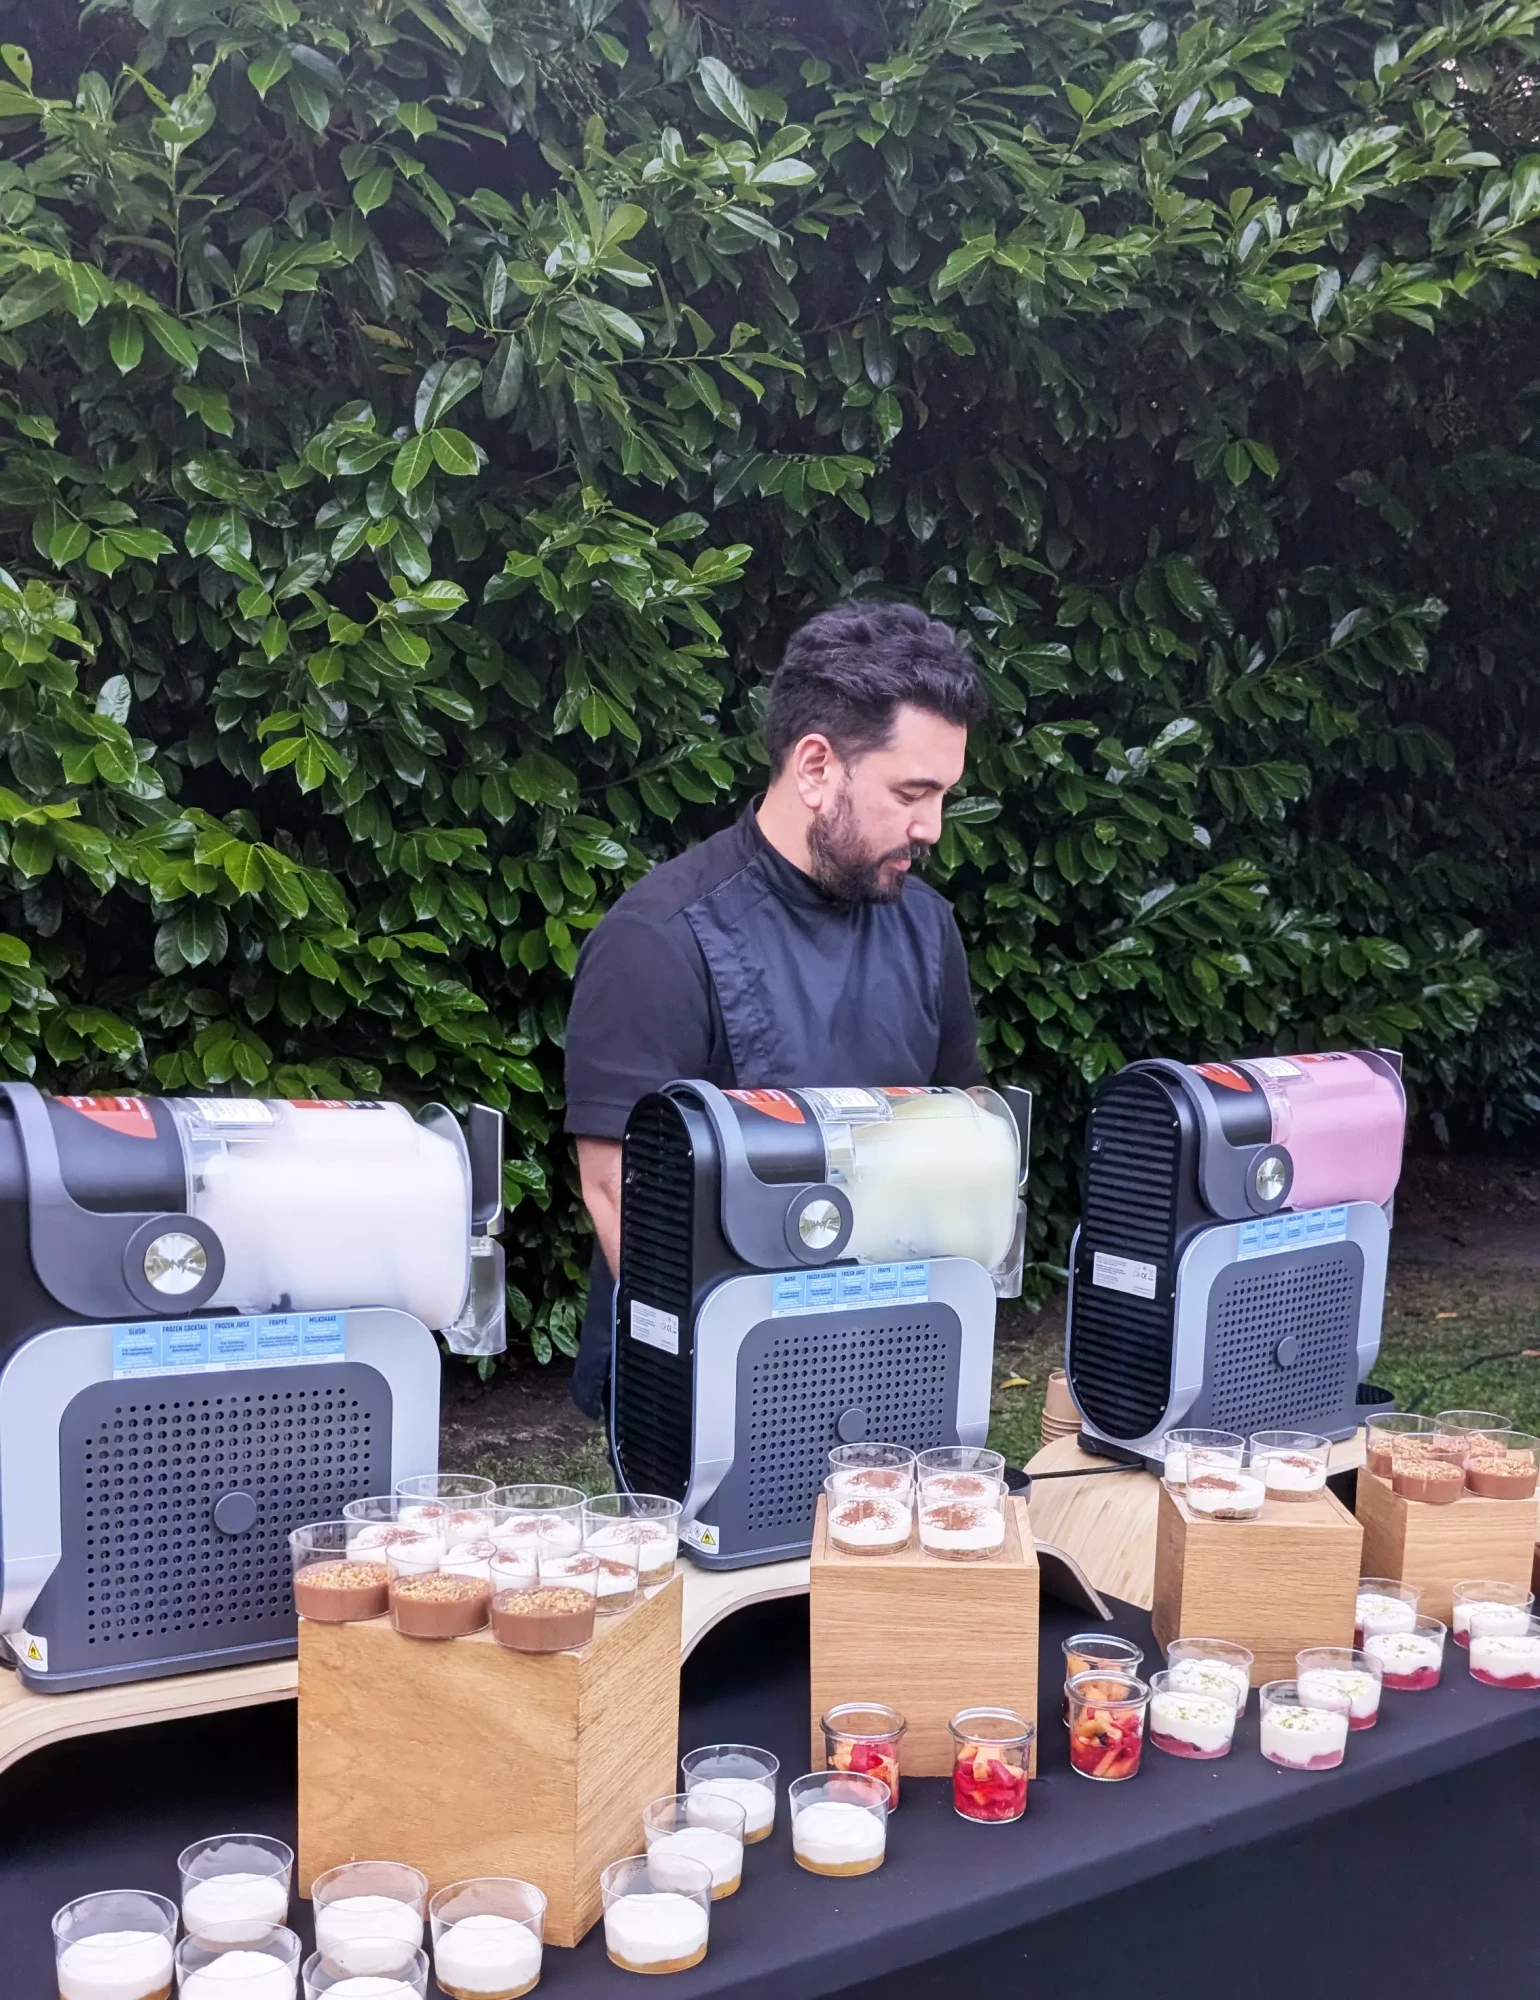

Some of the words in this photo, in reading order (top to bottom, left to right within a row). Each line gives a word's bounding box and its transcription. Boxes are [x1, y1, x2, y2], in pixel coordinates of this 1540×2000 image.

[268, 1317, 288, 1326] FRAPPÉ
[309, 1315, 337, 1323] MILKSHAKE
[162, 1325, 183, 1333] FROZEN
[184, 1324, 208, 1332] COCKTAIL
[214, 1321, 235, 1329] FROZEN
[236, 1320, 250, 1328] JUICE
[128, 1328, 146, 1336] SLUSH
